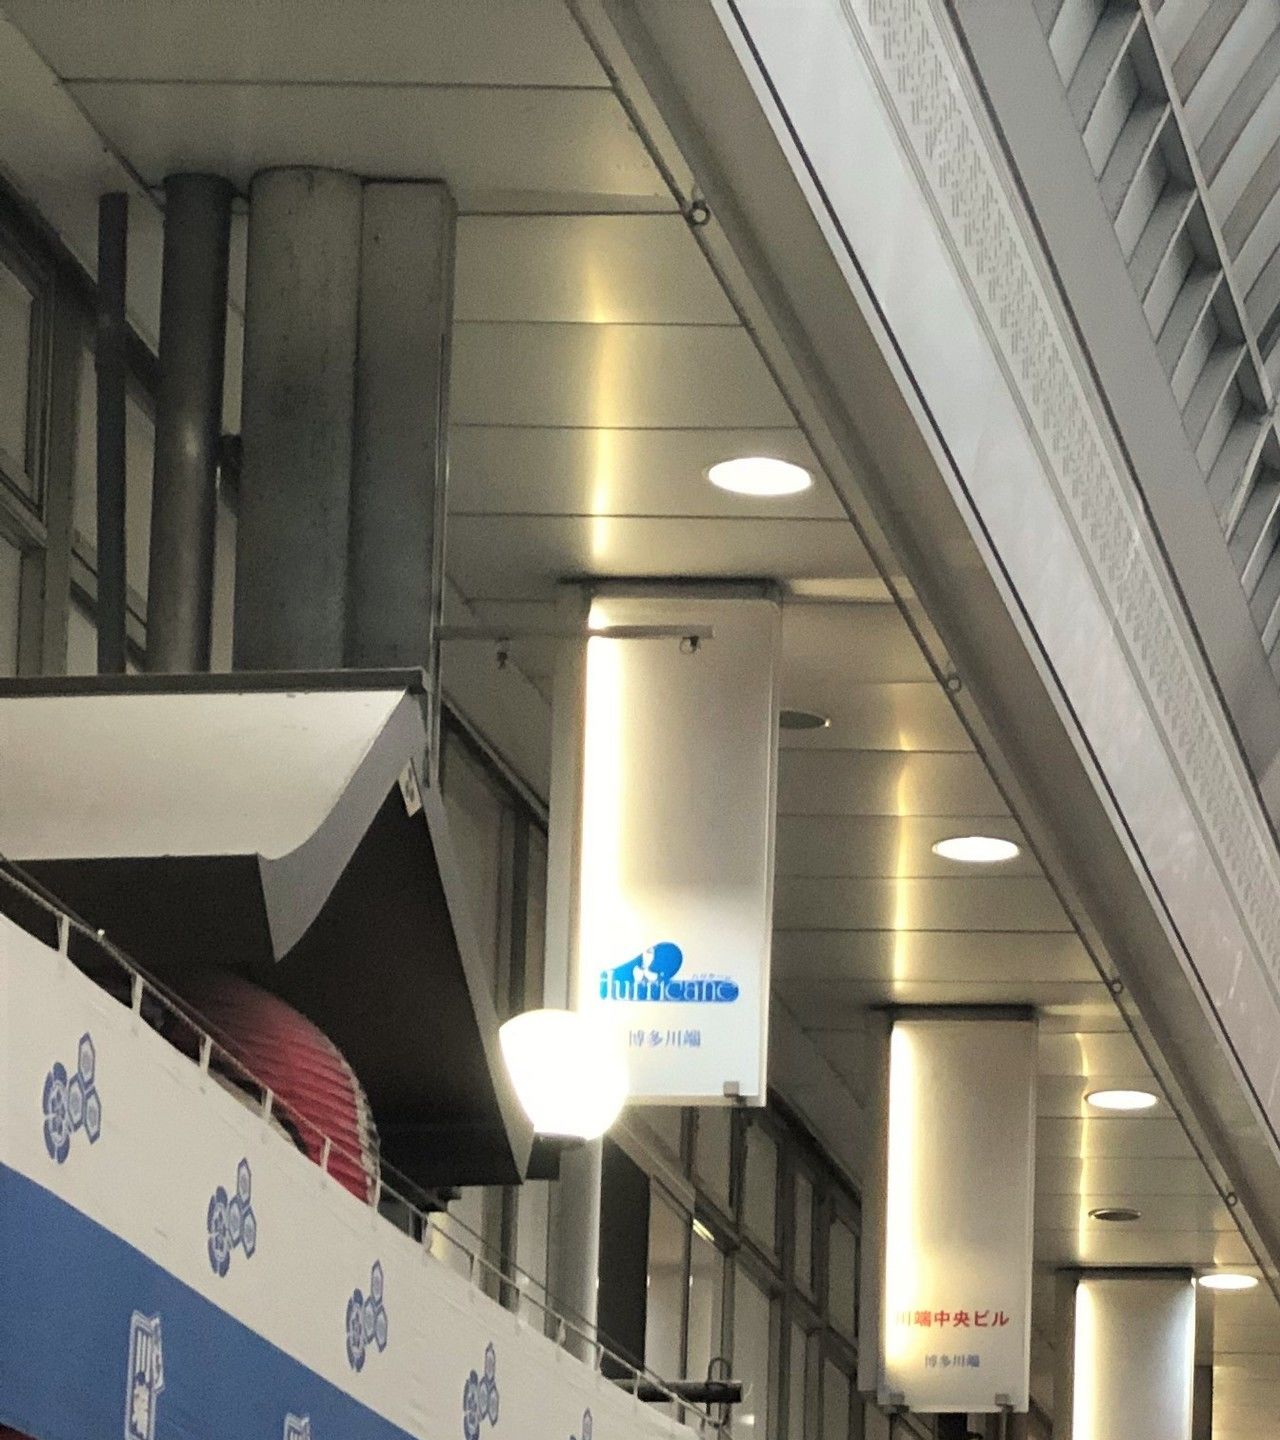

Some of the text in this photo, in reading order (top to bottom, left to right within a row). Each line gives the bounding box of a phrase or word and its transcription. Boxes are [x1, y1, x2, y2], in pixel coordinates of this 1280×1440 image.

[628, 1028, 702, 1048] 博多川端
[896, 1310, 1010, 1328] 川端中央ビル
